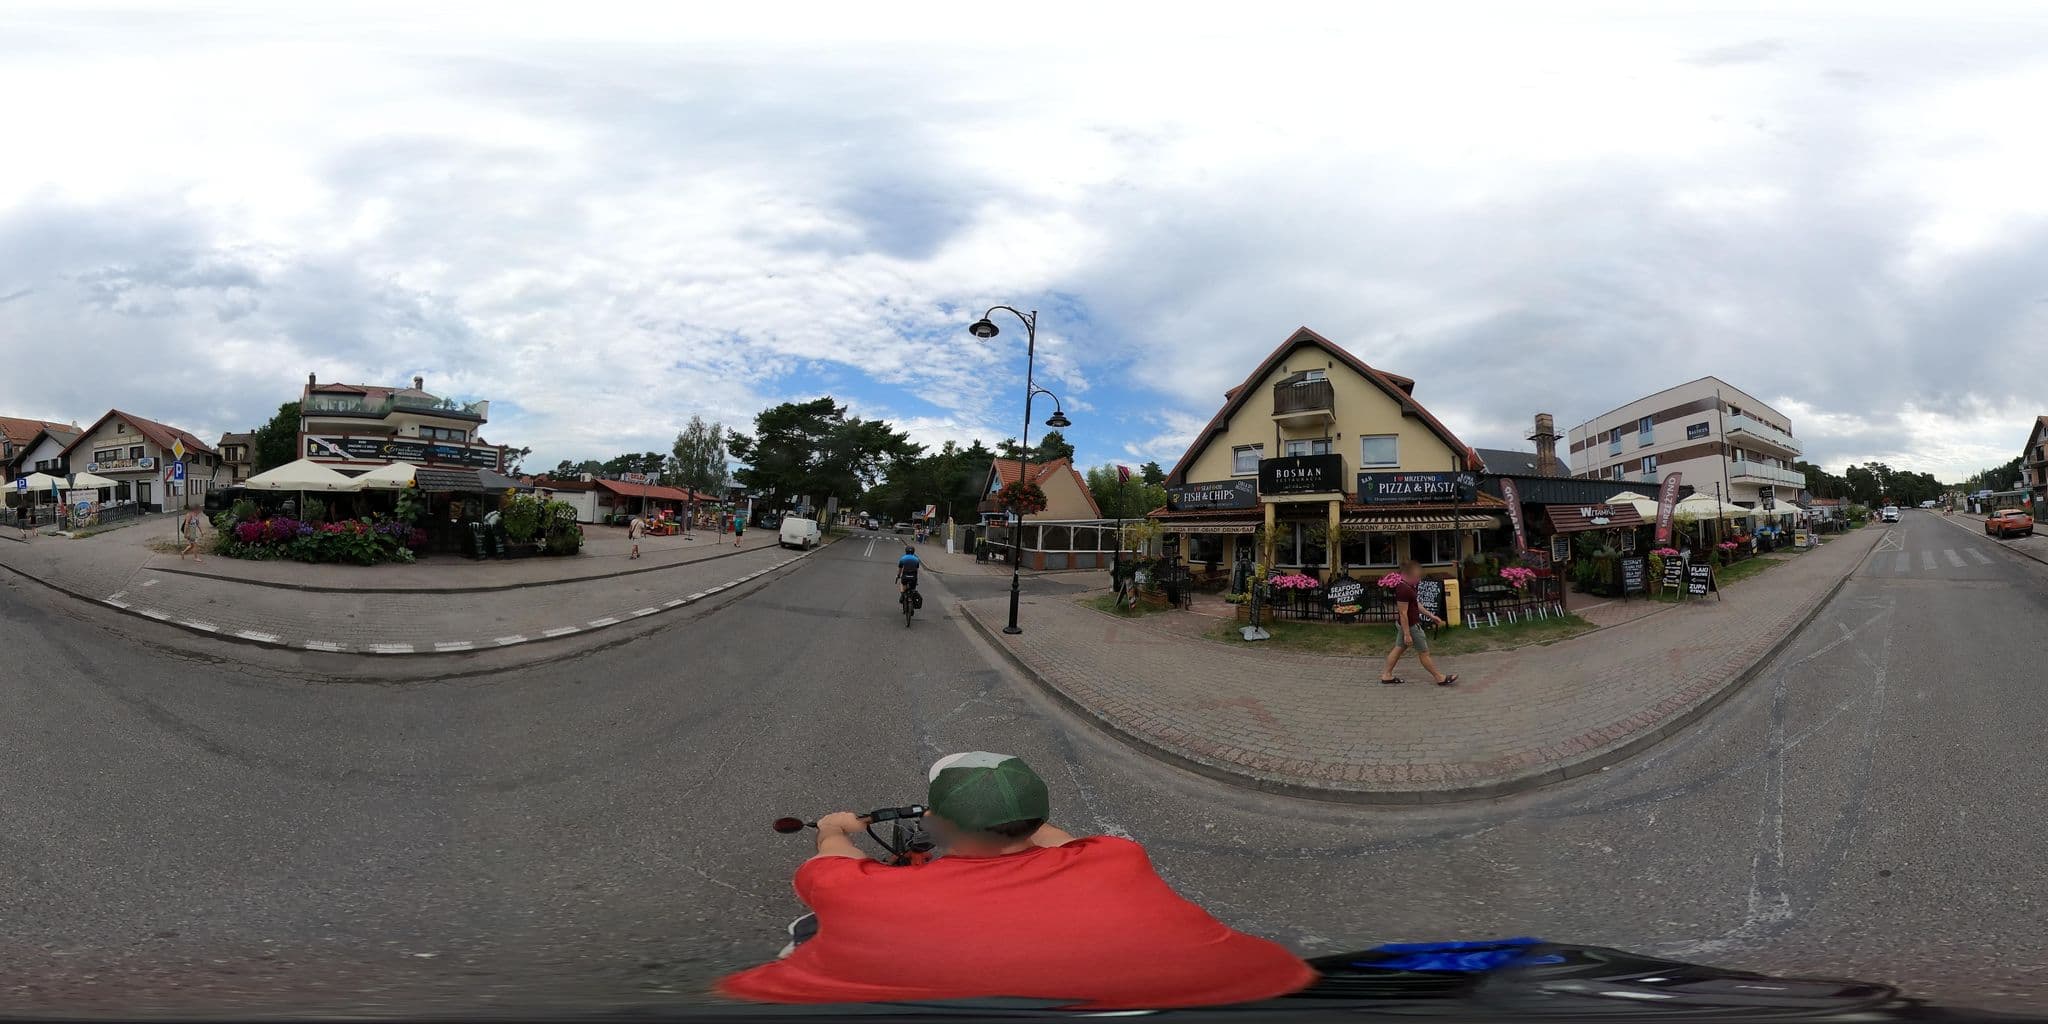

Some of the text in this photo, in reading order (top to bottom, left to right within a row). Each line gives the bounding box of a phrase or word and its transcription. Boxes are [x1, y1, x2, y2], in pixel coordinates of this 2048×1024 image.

[176, 463, 182, 477] P
[1276, 467, 1321, 478] BOSMAN
[19, 479, 25, 488] P
[1379, 483, 1411, 494] PIZZA
[1414, 483, 1422, 492] &
[1184, 491, 1201, 502] FISH
[1202, 491, 1208, 500] &
[1209, 489, 1234, 501] CHIPS
[1327, 588, 1364, 600] MAKARONY
[1330, 583, 1360, 594] SEAFOOD
